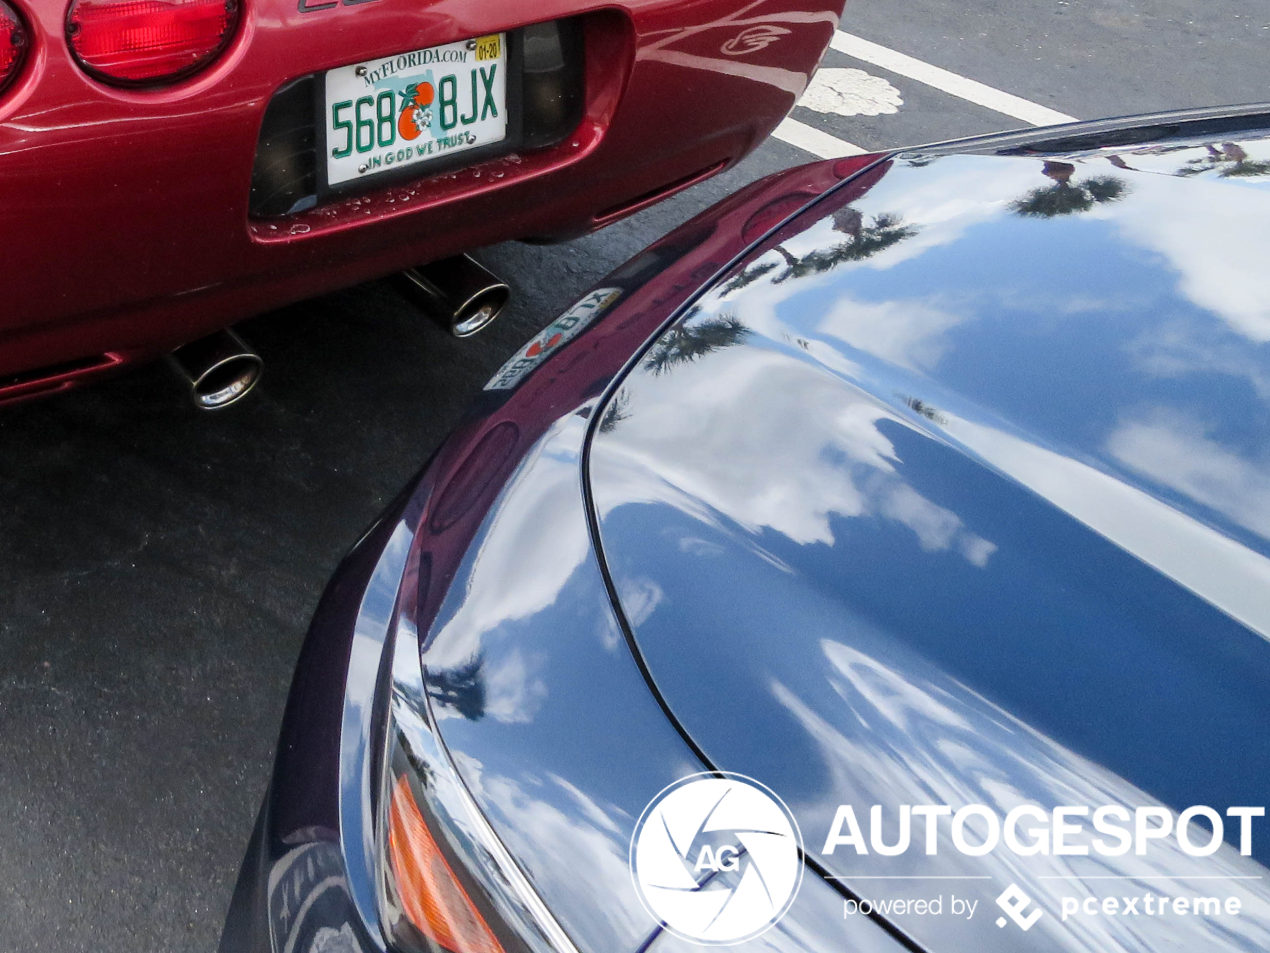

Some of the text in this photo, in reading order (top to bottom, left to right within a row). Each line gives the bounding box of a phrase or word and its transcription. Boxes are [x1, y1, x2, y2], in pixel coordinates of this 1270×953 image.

[364, 49, 468, 87] MYFLORIDA.COM
[478, 42, 497, 60] 01-20
[332, 64, 498, 159] 568 8JX
[367, 131, 471, 170] IN GOD WE TRUST
